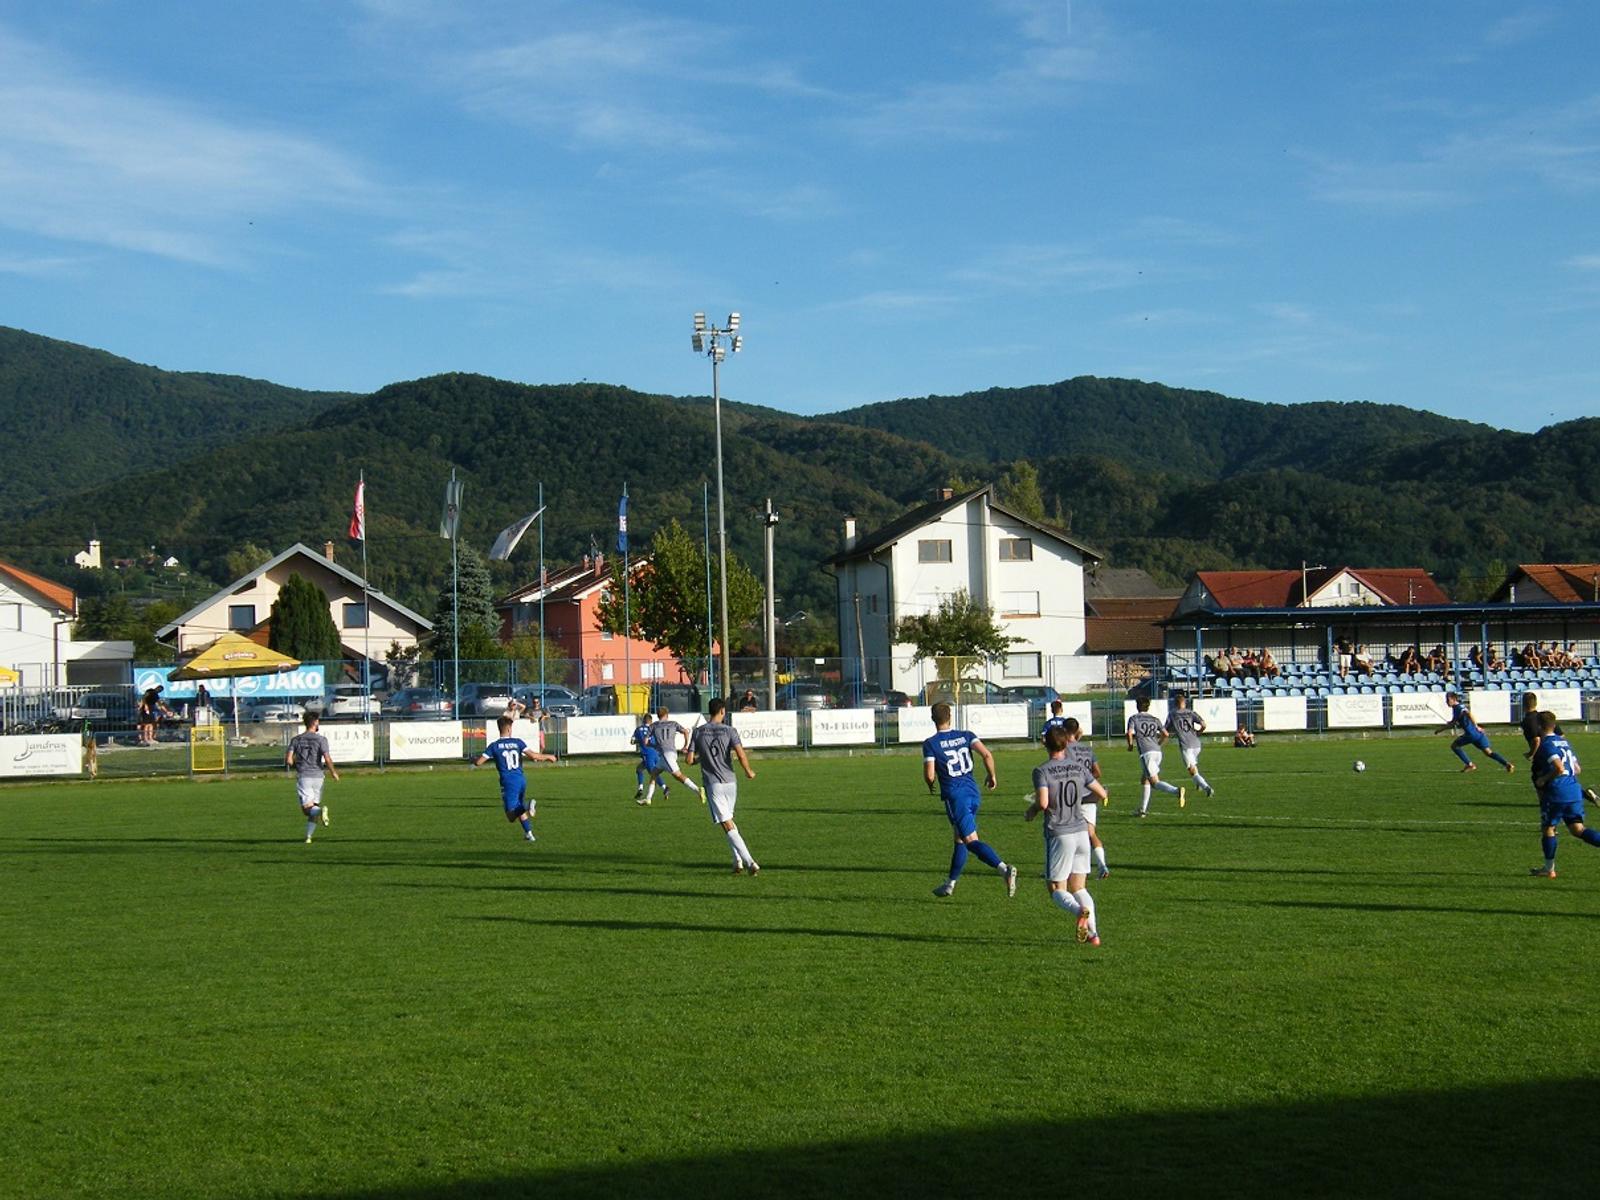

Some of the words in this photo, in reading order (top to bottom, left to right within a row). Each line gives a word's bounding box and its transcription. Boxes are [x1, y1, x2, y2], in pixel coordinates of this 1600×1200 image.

[170, 678, 226, 692] JAKO
[266, 671, 321, 690] JAKO
[408, 736, 459, 745] VINKOPROM
[662, 728, 670, 740] 11
[502, 749, 519, 770] 10
[944, 747, 973, 777] 20
[1058, 779, 1078, 808] 10
